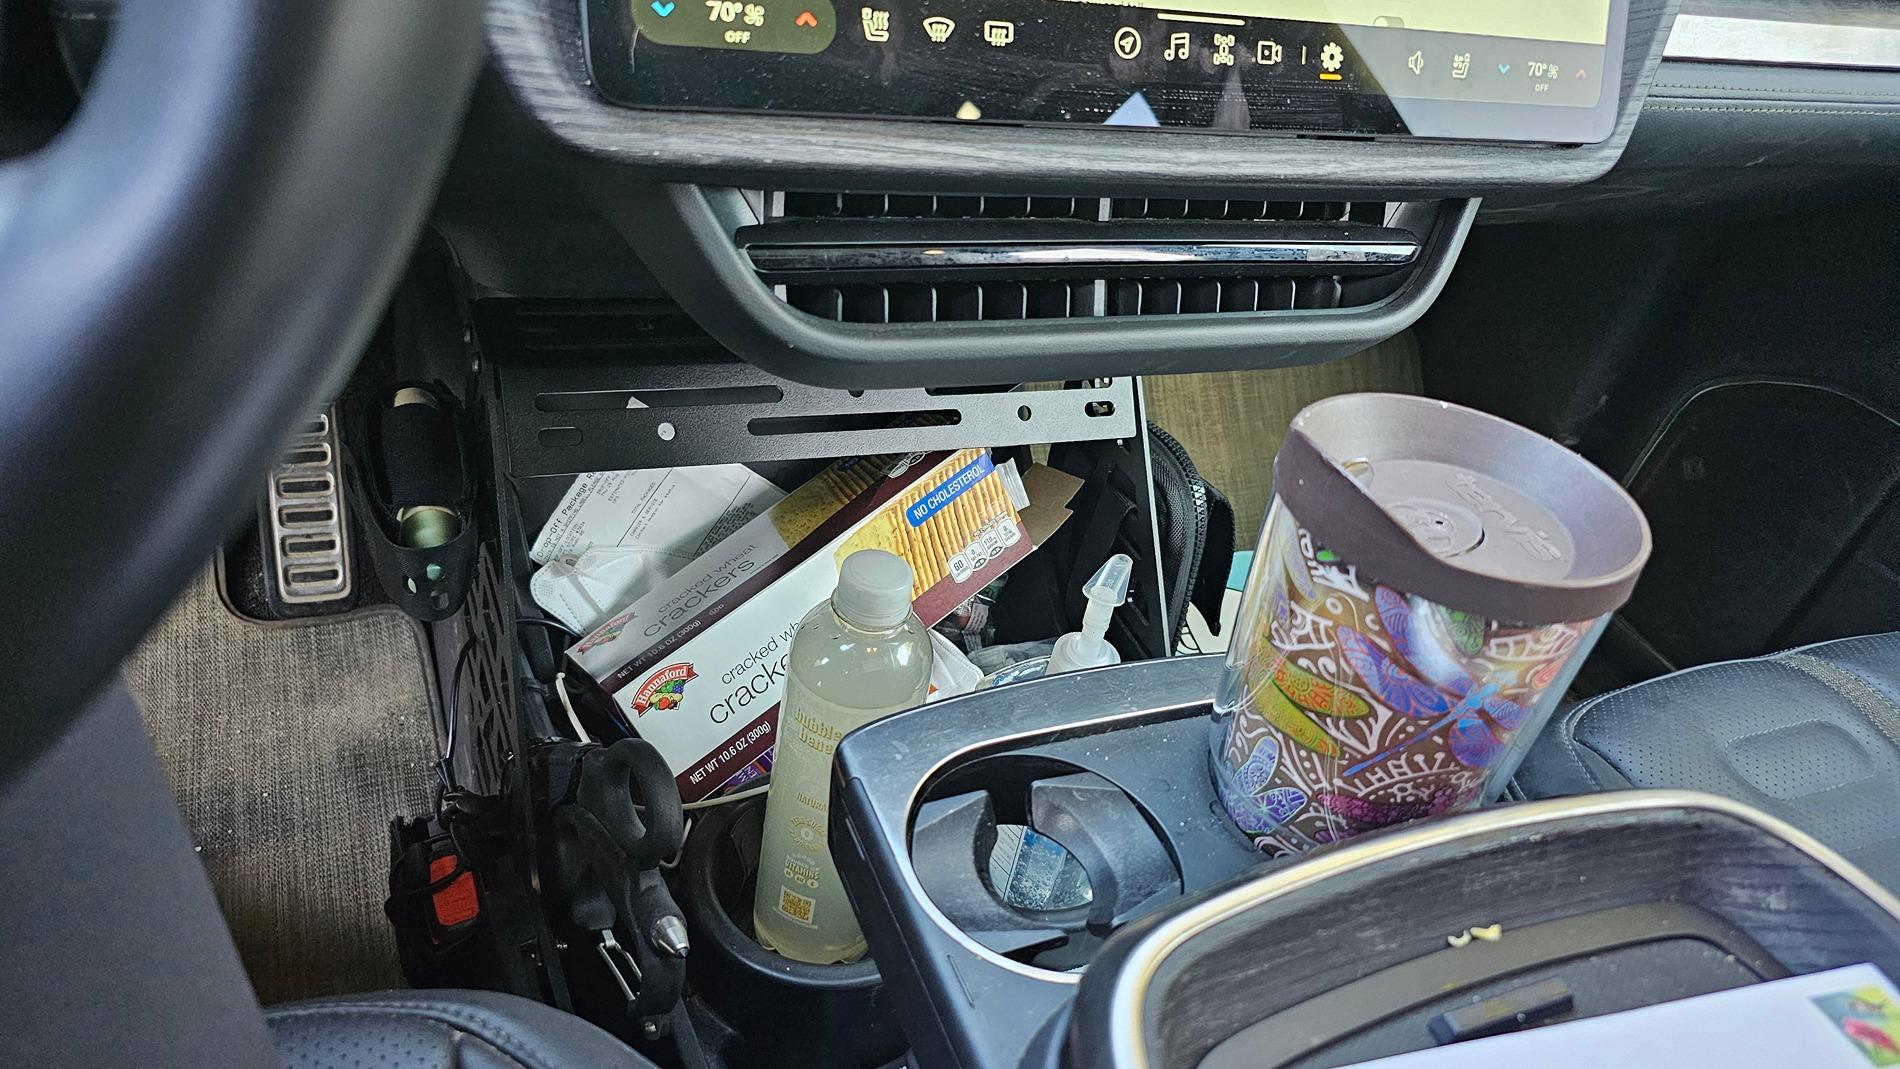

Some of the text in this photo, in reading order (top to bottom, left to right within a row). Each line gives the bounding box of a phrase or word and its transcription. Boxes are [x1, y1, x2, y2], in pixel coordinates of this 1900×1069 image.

[724, 30, 751, 43] OFF
[1527, 61, 1547, 76] 70°
[1534, 83, 1549, 92] OFF
[561, 482, 588, 516] Package
[913, 501, 928, 520] NO
[927, 462, 985, 510] CHOLESTEROL
[658, 571, 713, 614] cracked
[715, 543, 757, 580] wheat
[952, 559, 964, 571] 60
[643, 558, 755, 638] crackers
[618, 664, 634, 679] NET
[676, 619, 702, 641] (300g)
[721, 637, 779, 685] cracked
[637, 665, 690, 706] Hannaford
[689, 721, 772, 785] NET WT 10.6 OZ (300g)
[796, 792, 829, 814] NATURA
